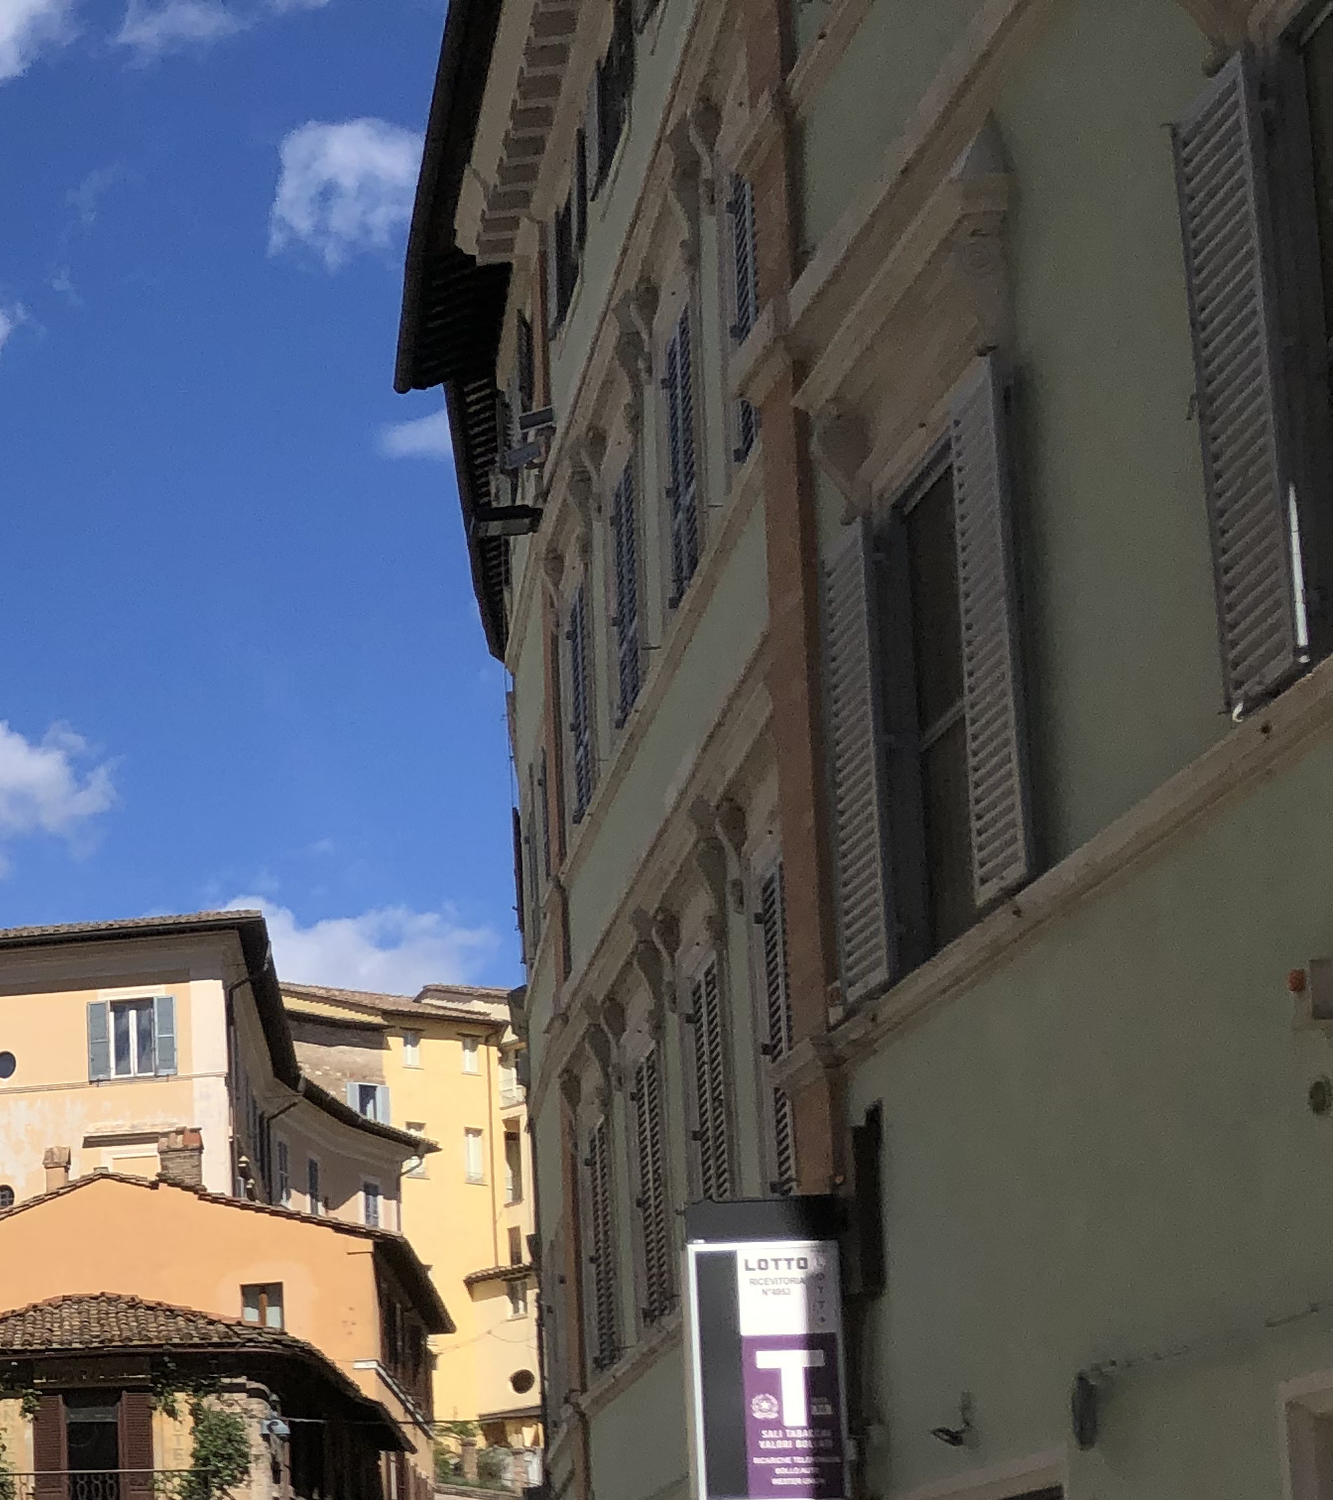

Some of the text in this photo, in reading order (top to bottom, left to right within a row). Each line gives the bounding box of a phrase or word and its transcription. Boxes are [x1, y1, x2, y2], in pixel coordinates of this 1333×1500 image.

[744, 1257, 809, 1271] LOTTO
[749, 1277, 806, 1287] RICEVITORIA
[755, 1349, 826, 1428] T
[761, 1429, 783, 1439] SALI
[758, 1440, 793, 1449] VALORI
